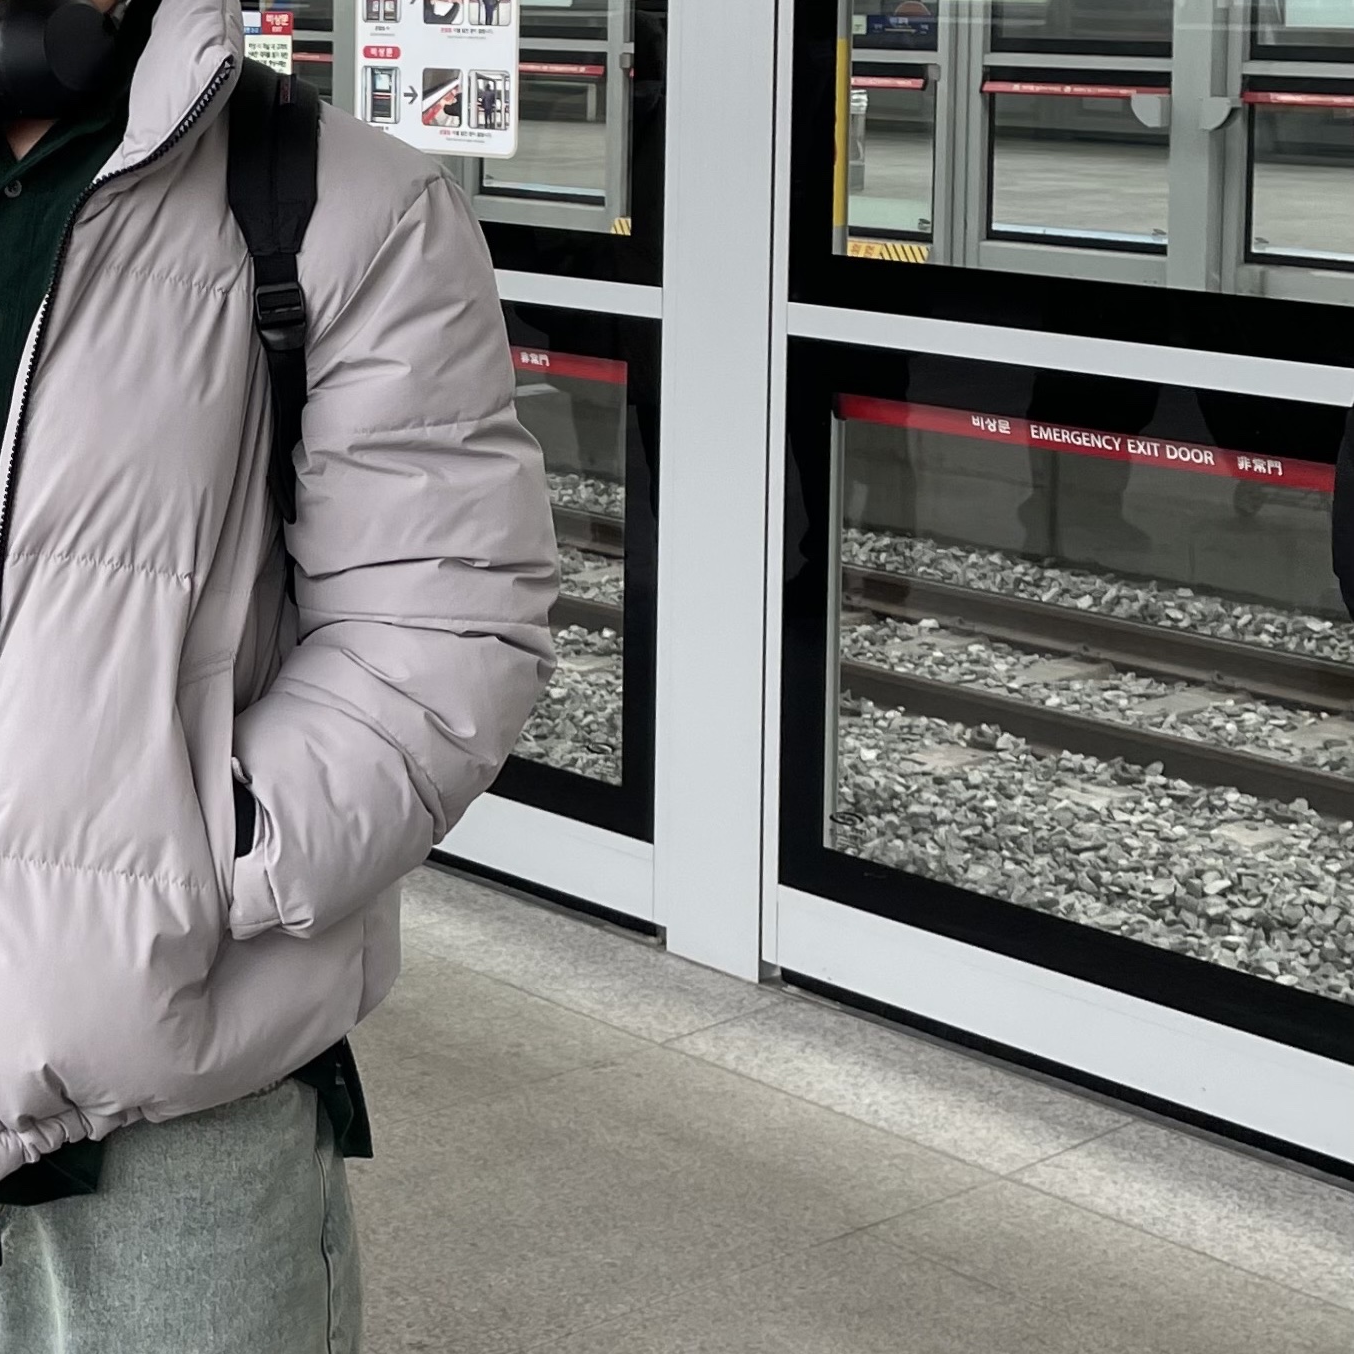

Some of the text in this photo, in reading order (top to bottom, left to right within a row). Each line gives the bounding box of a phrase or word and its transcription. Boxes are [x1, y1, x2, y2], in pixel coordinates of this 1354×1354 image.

[971, 415, 1283, 477] 비상문 EMERGENCY EXIT DOOR 非常門
